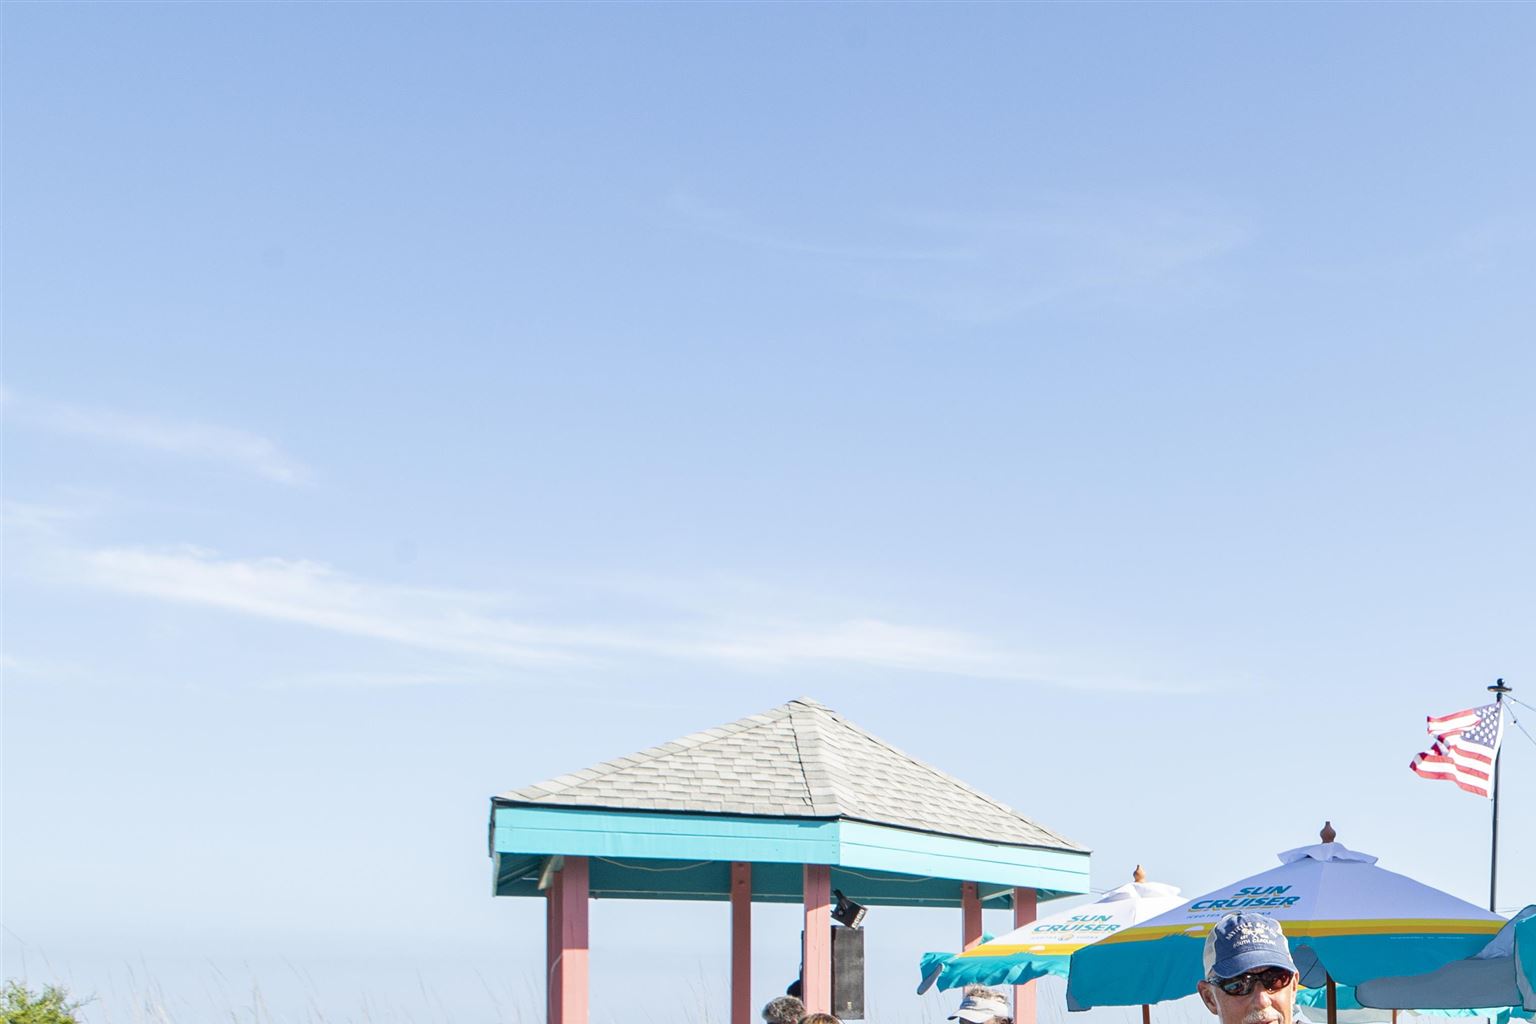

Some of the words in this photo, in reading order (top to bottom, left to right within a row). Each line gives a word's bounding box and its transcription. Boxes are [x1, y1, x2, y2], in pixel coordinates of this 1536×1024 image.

[1233, 885, 1293, 897] SUN
[1190, 896, 1301, 911] CRUISER
[1067, 914, 1113, 923] SUN
[1033, 924, 1121, 932] CRUISER
